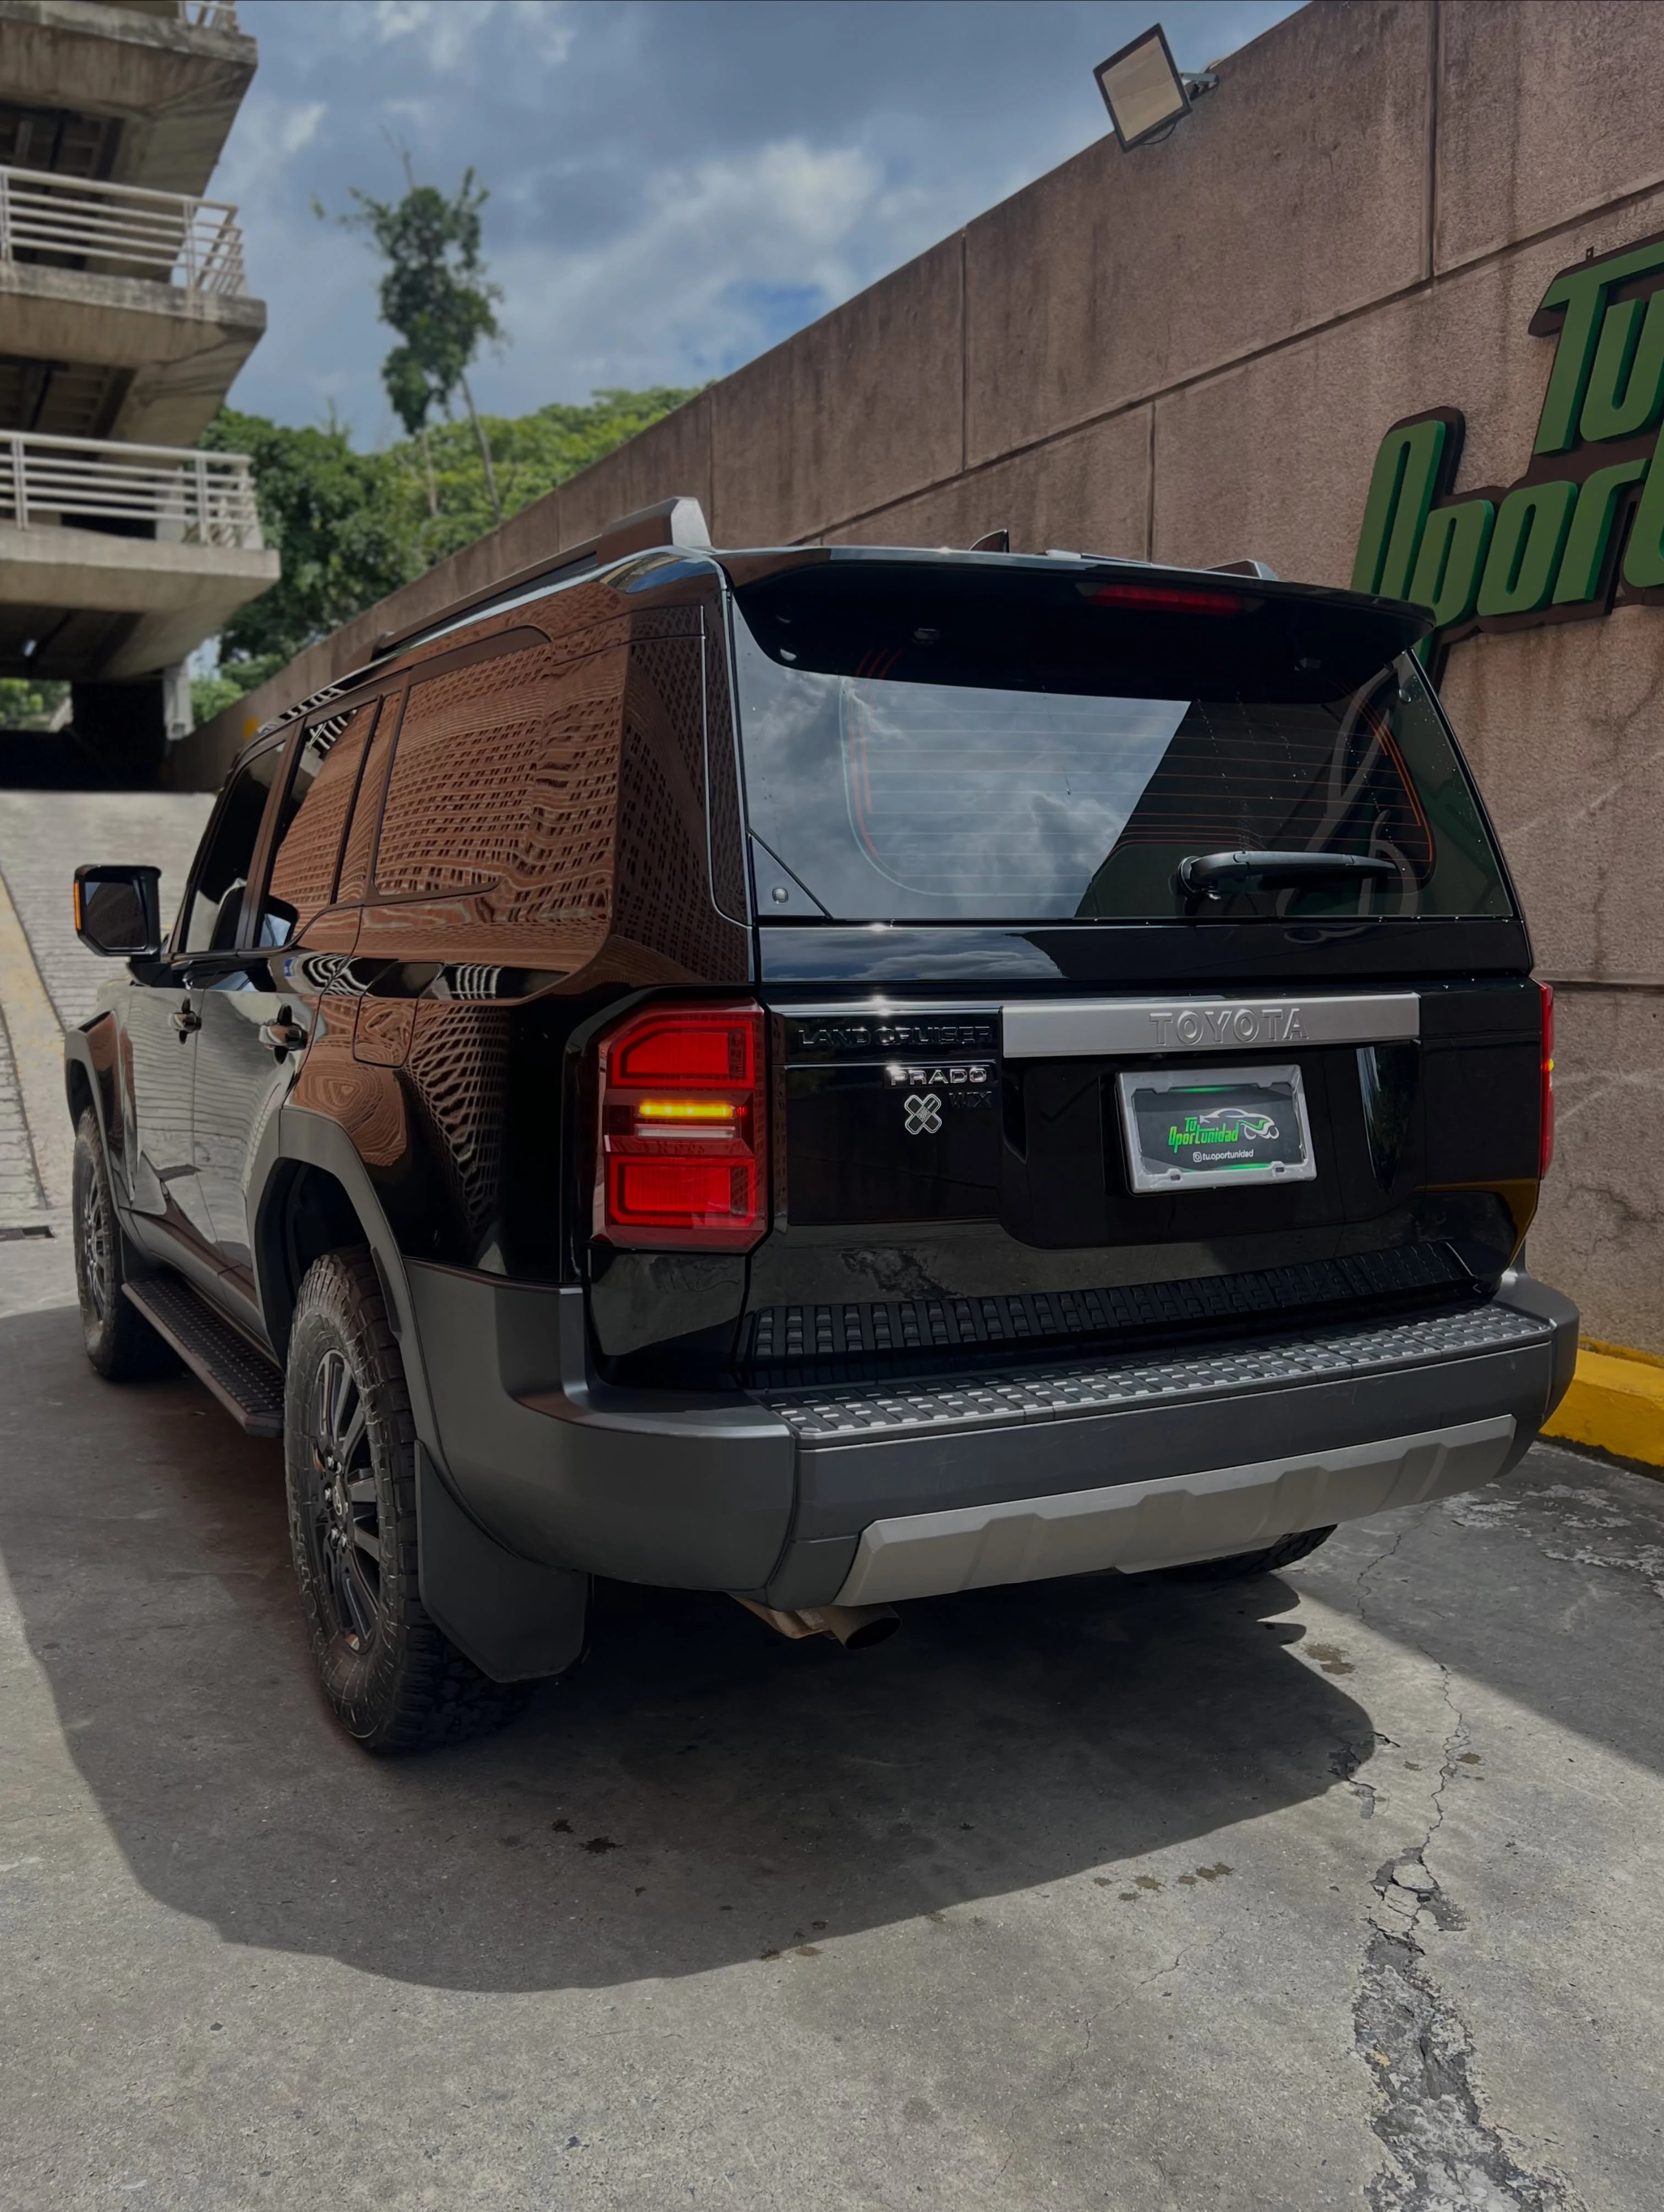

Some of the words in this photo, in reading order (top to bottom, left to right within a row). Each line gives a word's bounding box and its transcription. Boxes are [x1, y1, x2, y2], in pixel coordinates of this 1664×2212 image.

[798, 1027, 872, 1045] LAND
[875, 1025, 992, 1045] CRUISER
[1149, 1008, 1309, 1046] TOYOTA
[889, 1067, 987, 1086] PRADO
[1168, 1122, 1239, 1153] Oportunidad
